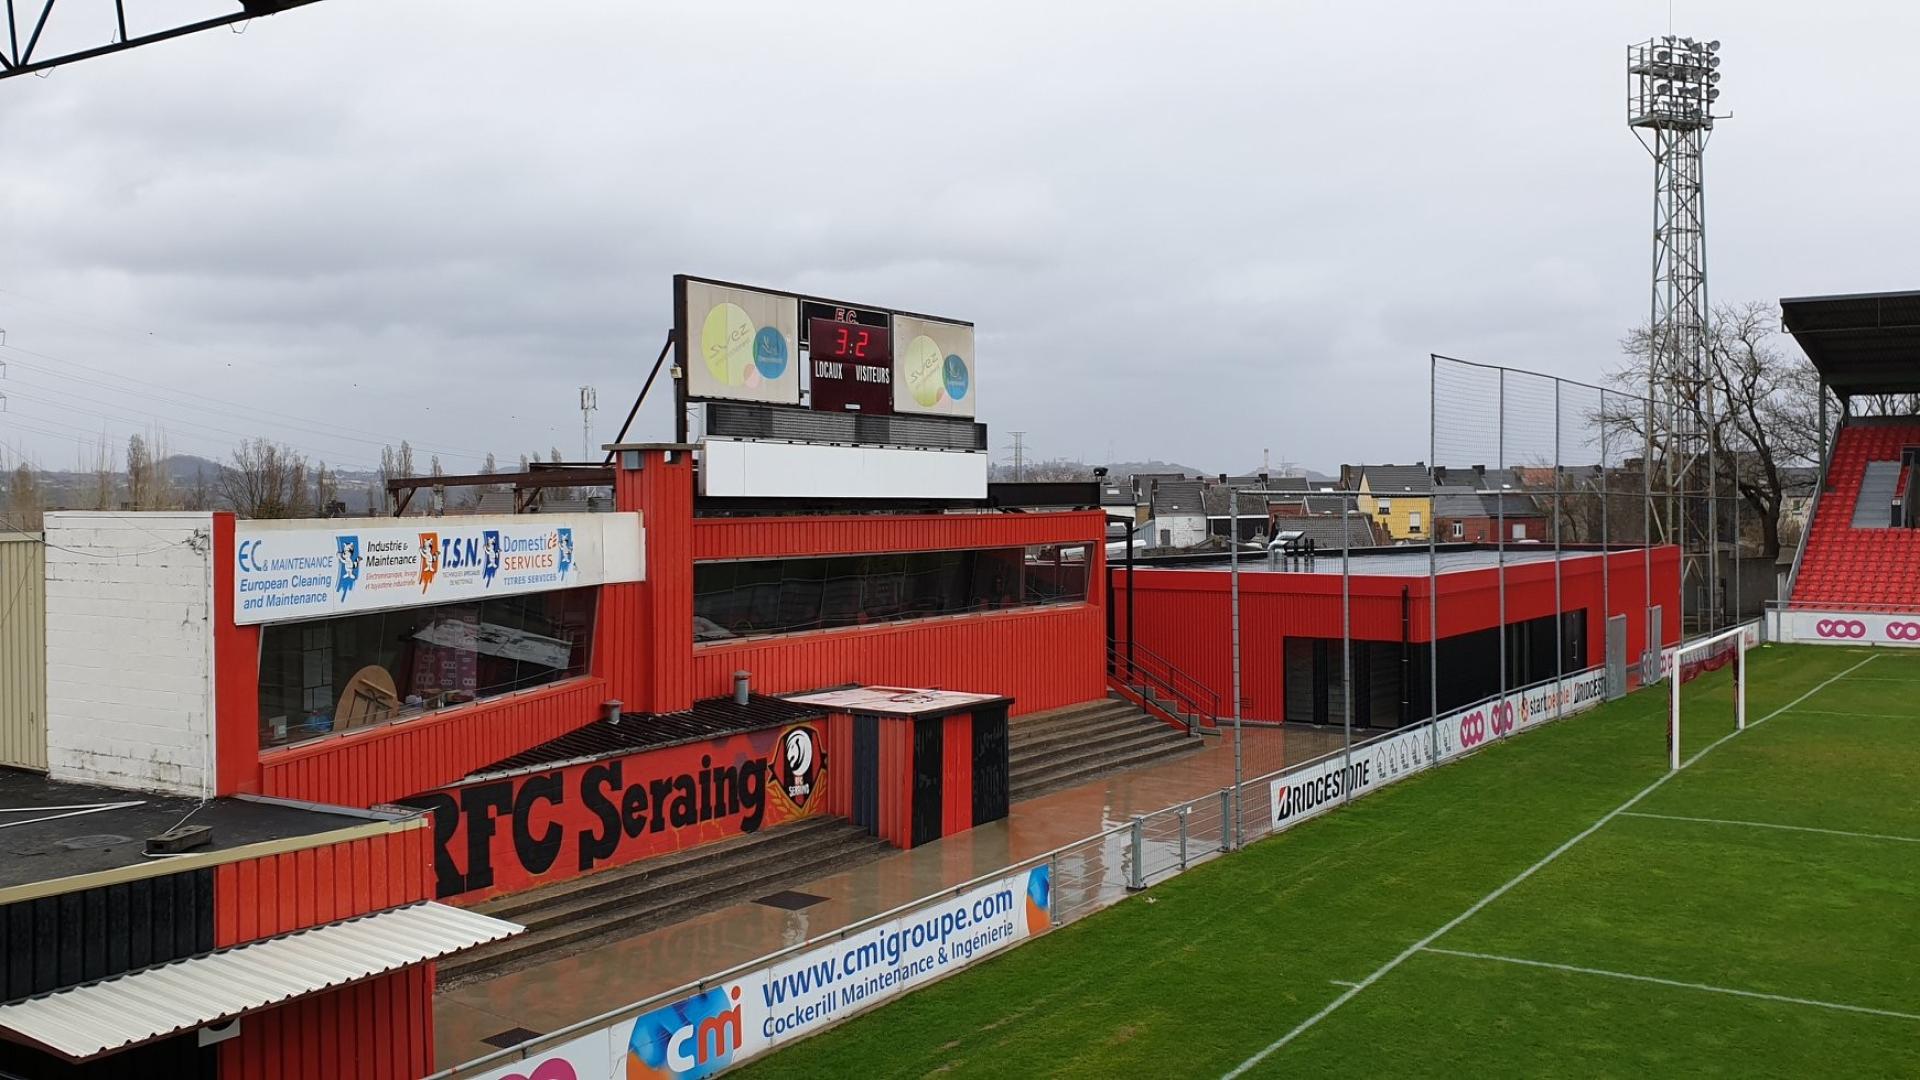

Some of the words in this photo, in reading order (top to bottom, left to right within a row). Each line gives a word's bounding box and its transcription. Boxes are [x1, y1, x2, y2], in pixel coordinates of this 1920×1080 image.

[815, 360, 843, 380] LOCAUX
[855, 364, 890, 384] VISITEURS
[367, 539, 403, 552] Industrie
[442, 538, 481, 568] T.S.N.
[504, 534, 553, 553] Domestic
[238, 540, 262, 572] EC
[271, 556, 333, 571] MAINTENANCE
[366, 555, 417, 567] Maintenance
[504, 554, 553, 571] SERVICES
[240, 577, 289, 593] European
[291, 574, 332, 589] Cleaning
[504, 575, 526, 586] TITRES
[528, 573, 557, 584] SERVICES
[243, 597, 263, 609] and
[266, 592, 327, 607] Maintenance
[1886, 622, 1920, 640] VO
[1530, 686, 1569, 716] startpeple
[402, 771, 563, 898] RFC
[579, 754, 767, 872] Seraing
[762, 888, 1014, 1008] www.cmigroupe.com
[763, 991, 837, 1038] Cockerill
[842, 956, 934, 1006] Maintenance
[938, 946, 949, 965] &
[951, 920, 1014, 960] Ingénierie
[667, 985, 743, 1073] cmi
